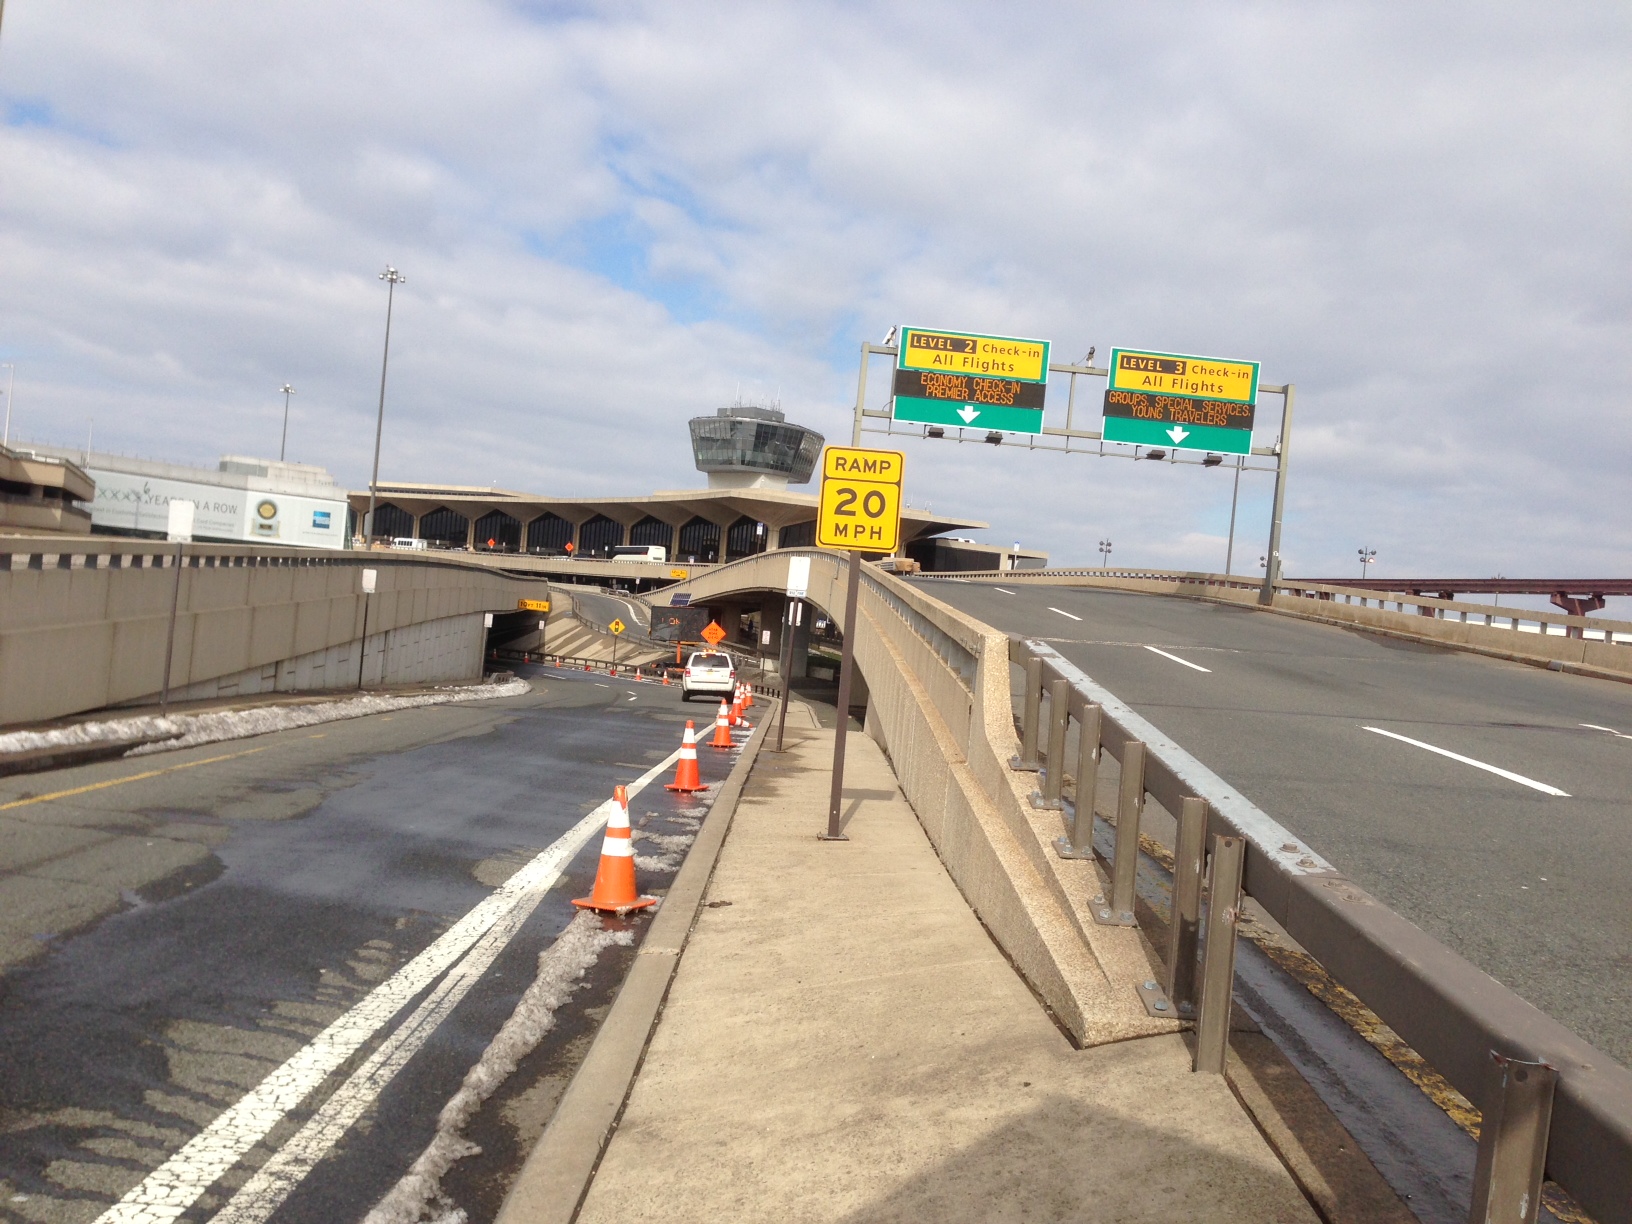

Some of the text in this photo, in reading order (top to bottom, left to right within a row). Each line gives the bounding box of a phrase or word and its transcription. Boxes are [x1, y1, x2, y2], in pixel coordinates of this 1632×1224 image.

[913, 336, 1040, 358] LEVEL 2 Check-in
[932, 354, 1015, 372] All Flights
[1123, 357, 1249, 379] LEVEL 3 Check-in
[920, 373, 1021, 394] ECONOMY CHECK-IN
[1142, 375, 1224, 394] All Flights
[925, 385, 1014, 405] PREMIER ACCESS
[1155, 395, 1196, 411] SPECIAL
[1131, 405, 1227, 426] YOUNG TRAVELERS
[835, 456, 891, 475] RAMP
[202, 501, 210, 511] A
[834, 487, 886, 519] 20
[834, 522, 882, 541] MPH
